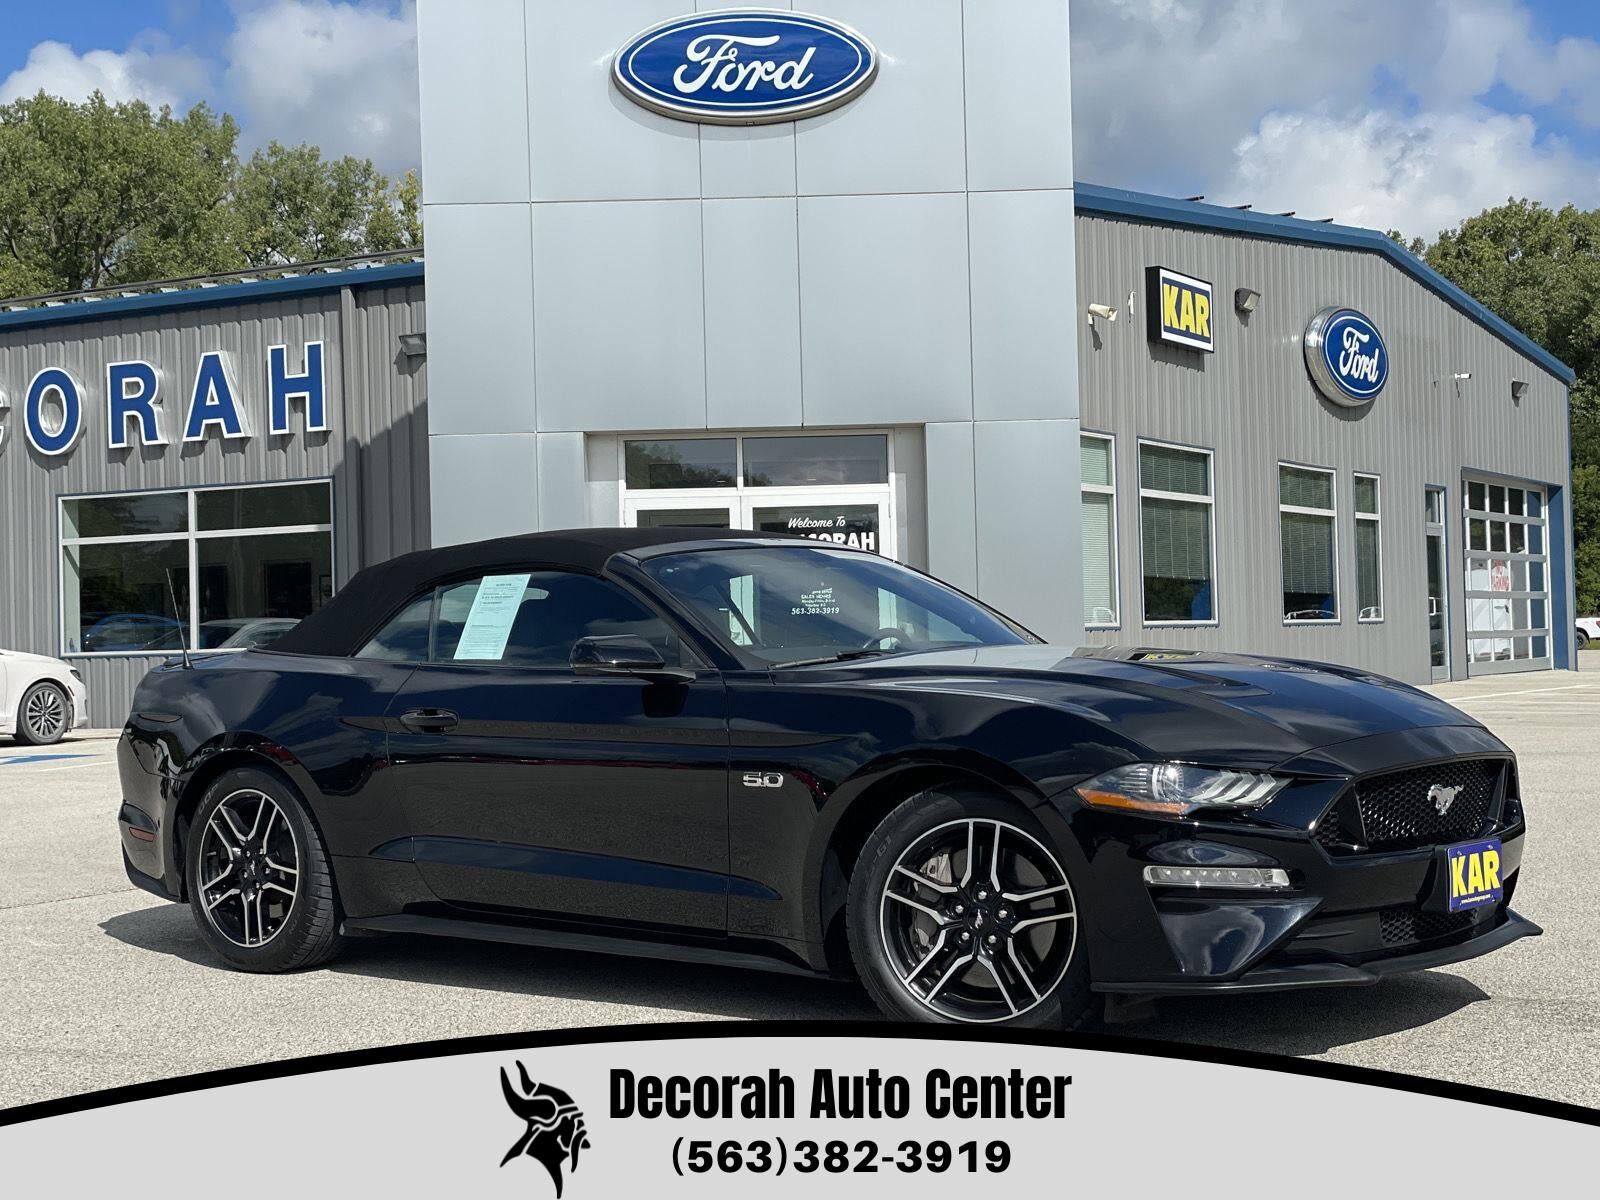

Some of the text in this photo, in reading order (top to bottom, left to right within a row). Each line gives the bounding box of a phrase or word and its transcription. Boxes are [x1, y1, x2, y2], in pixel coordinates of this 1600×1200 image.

[673, 34, 817, 94] Ford
[1163, 283, 1211, 338] KAR
[1339, 326, 1380, 384] Ford
[0, 340, 328, 456] ORAH
[788, 515, 846, 529] Welcome To
[1451, 849, 1501, 898] KAR
